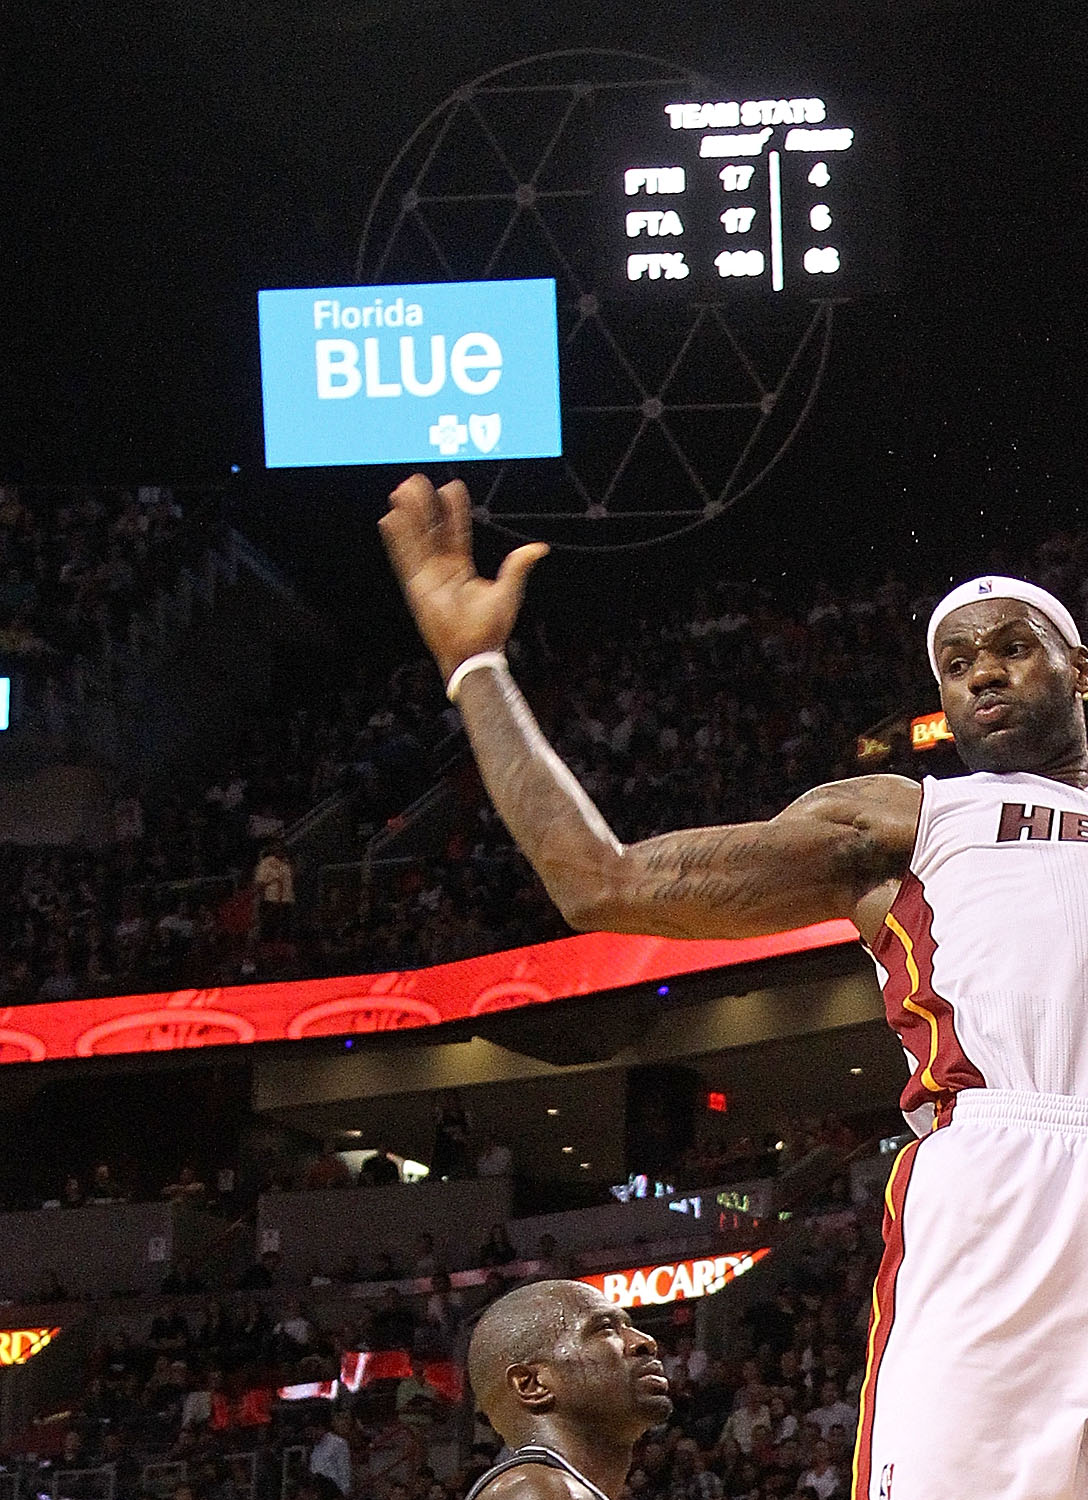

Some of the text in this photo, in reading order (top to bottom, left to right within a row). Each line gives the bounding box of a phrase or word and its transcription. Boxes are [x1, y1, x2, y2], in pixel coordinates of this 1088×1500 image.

[664, 98, 826, 129] TEAM STATS
[719, 163, 755, 191] 17
[808, 161, 831, 187] 4
[626, 203, 832, 237] FTA 17 6
[313, 299, 423, 329] Florida
